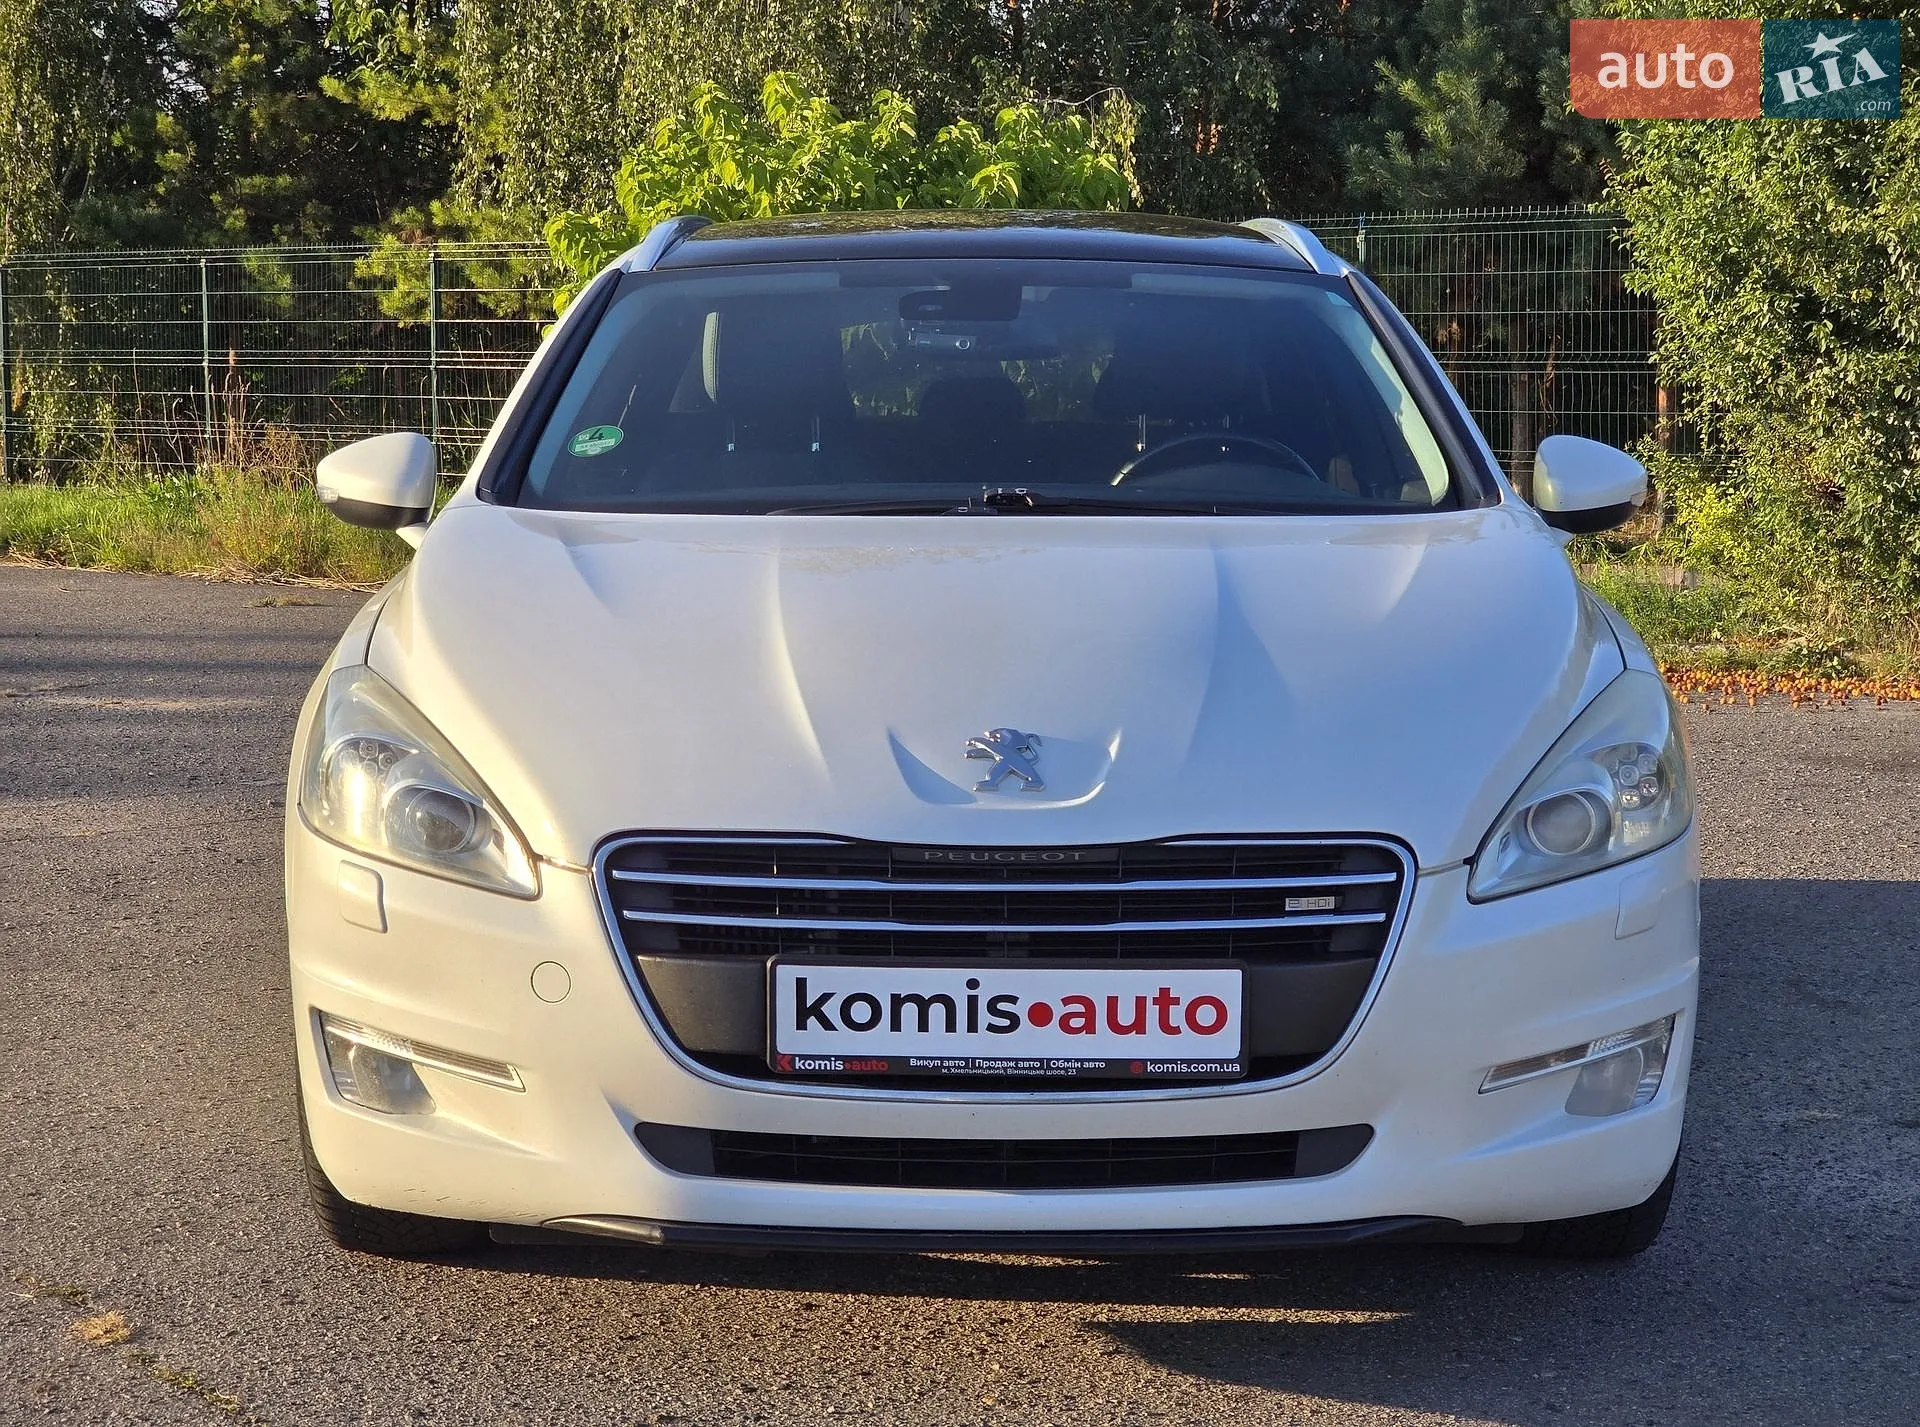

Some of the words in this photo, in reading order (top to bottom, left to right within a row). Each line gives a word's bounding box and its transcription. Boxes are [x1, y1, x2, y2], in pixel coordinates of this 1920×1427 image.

[924, 851, 1086, 862] PEUGEOT
[910, 1058, 940, 1067] Викуп
[975, 1060, 1016, 1068] Продаж
[1050, 1060, 1080, 1068] Обмін
[1083, 1061, 1106, 1069] авто
[1147, 1061, 1240, 1073] komis.com.ua
